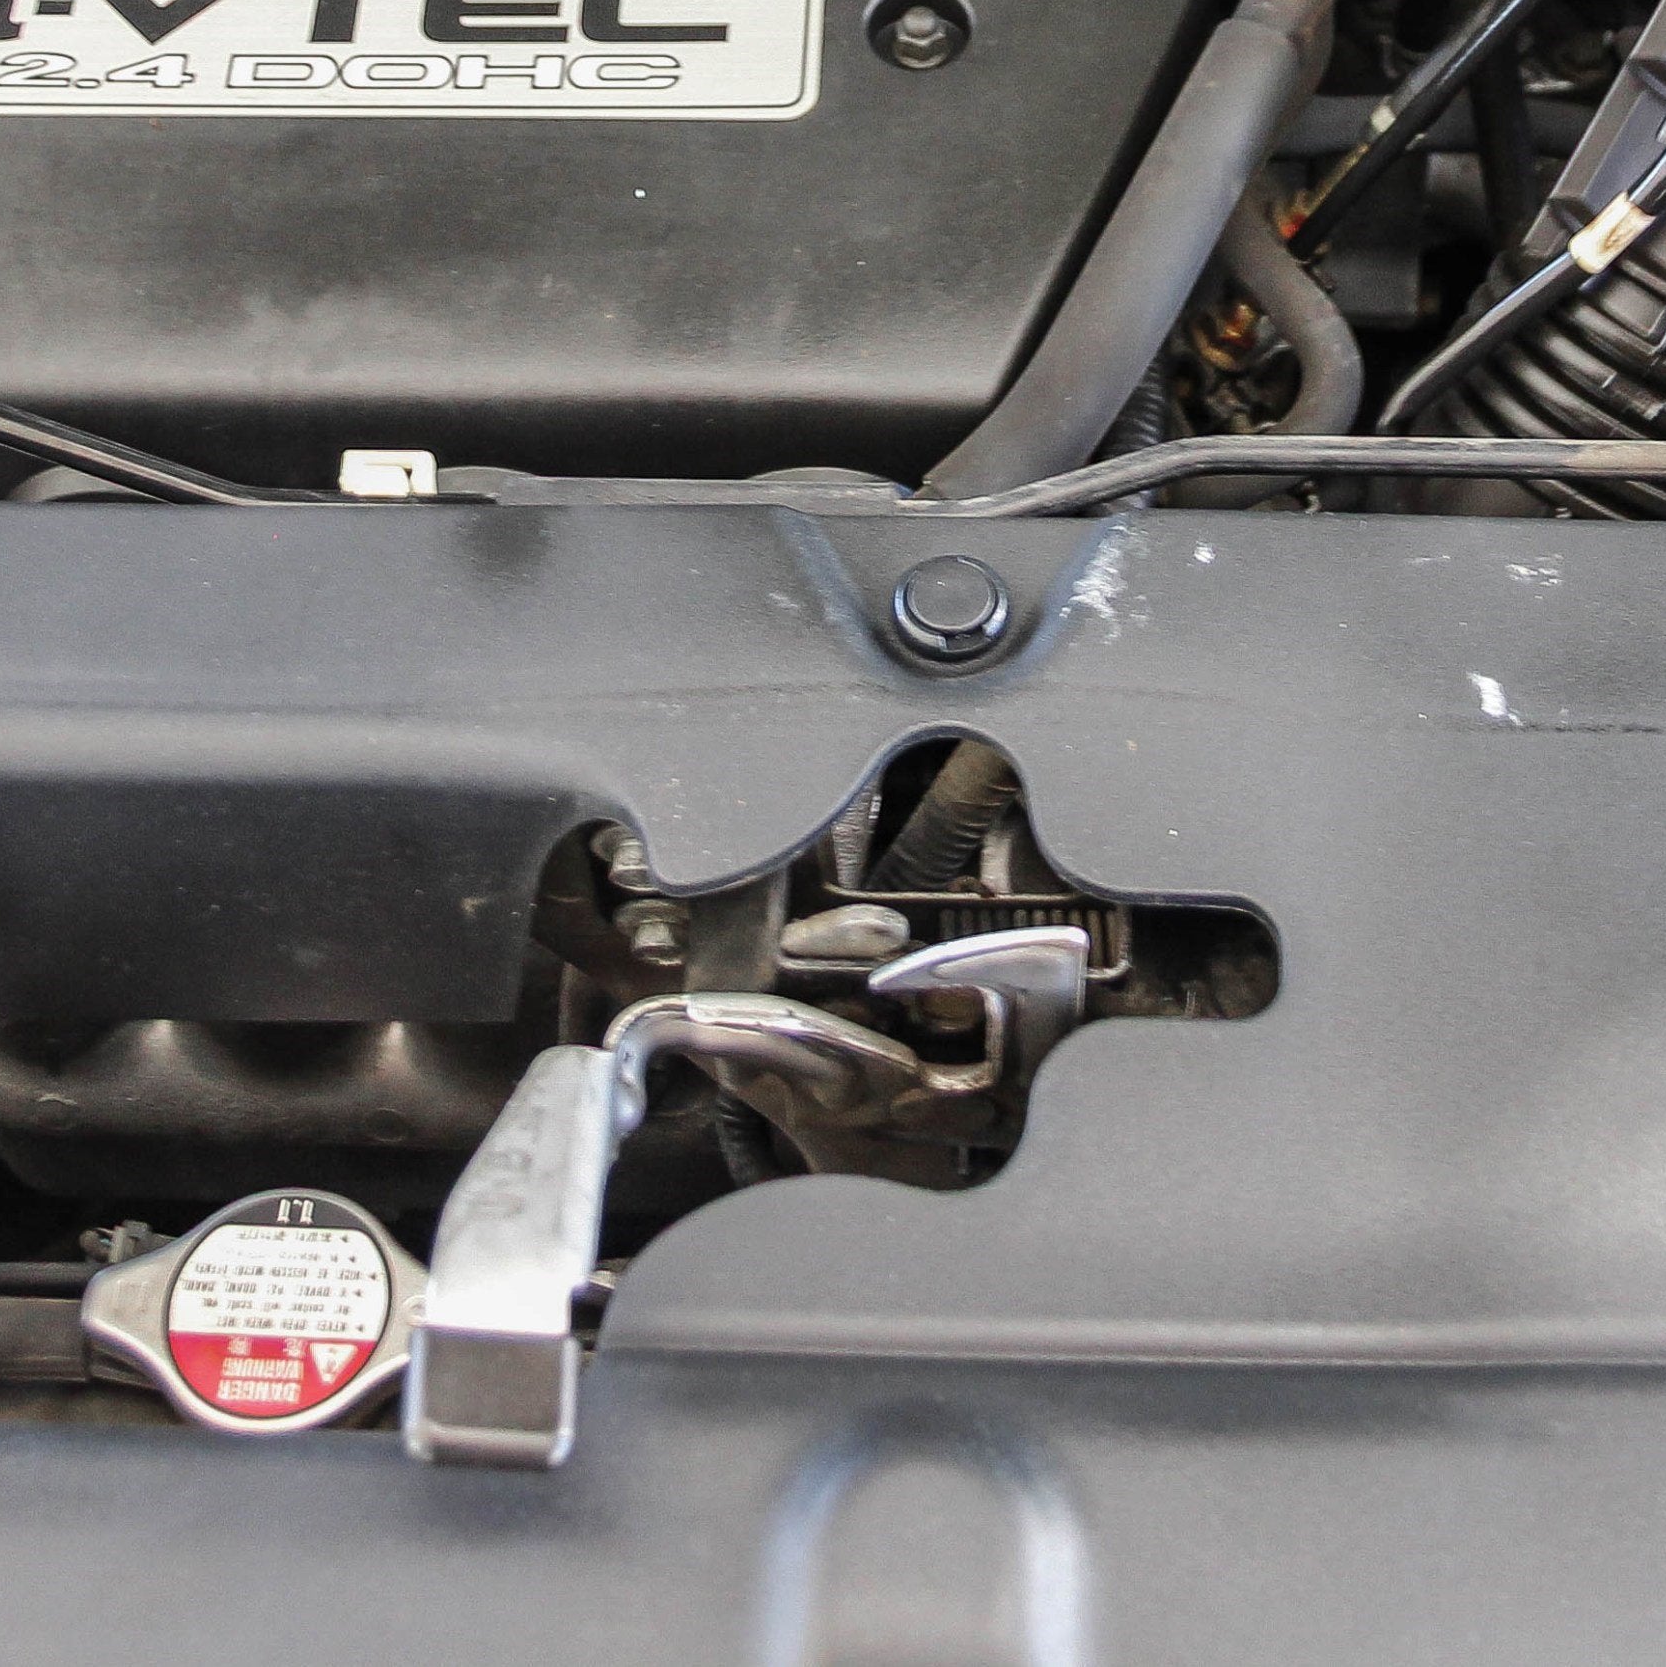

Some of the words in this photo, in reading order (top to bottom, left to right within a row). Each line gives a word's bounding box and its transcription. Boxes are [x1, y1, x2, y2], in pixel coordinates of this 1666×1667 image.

[225, 53, 683, 90] DOHC
[277, 1199, 315, 1224] 1.1
[217, 1379, 302, 1405] DANGER
